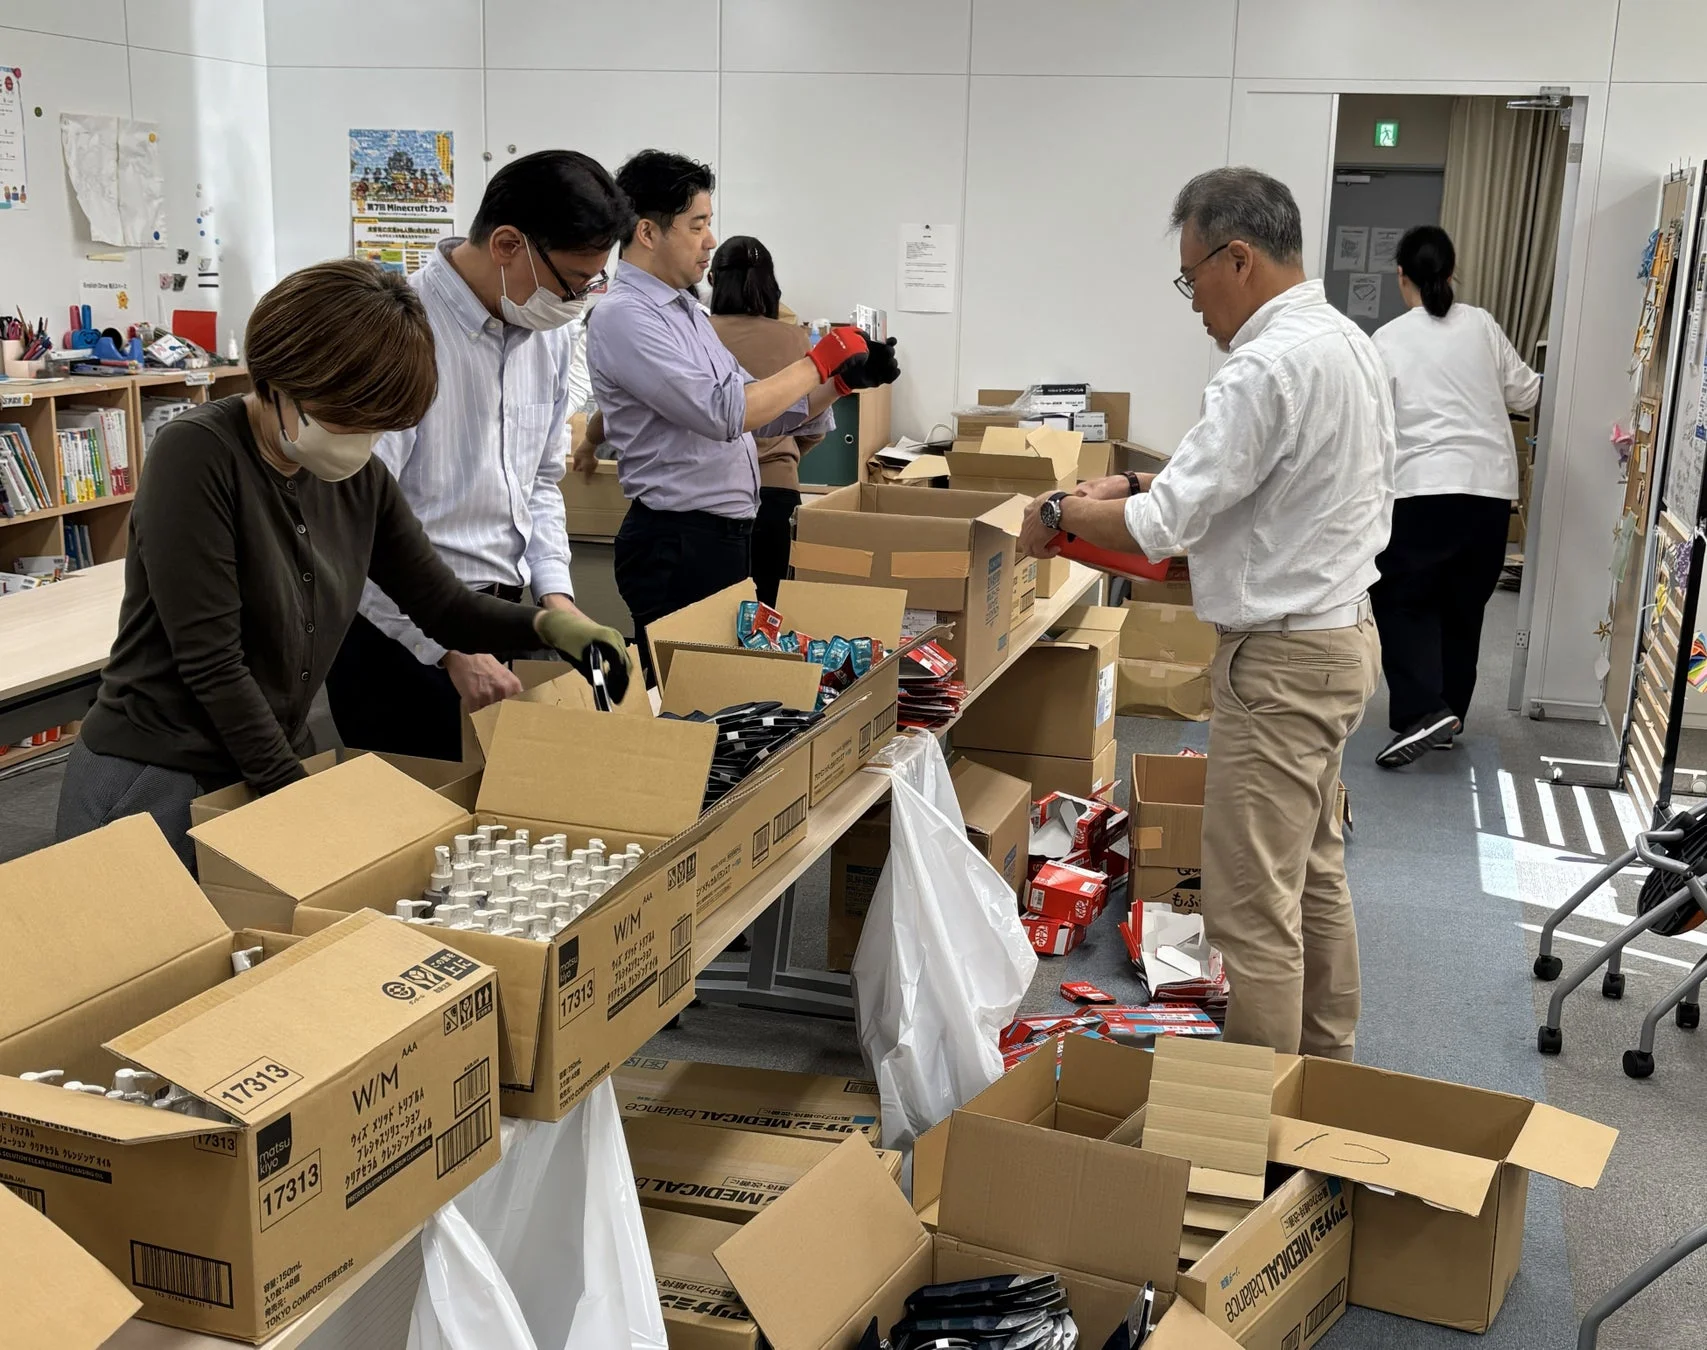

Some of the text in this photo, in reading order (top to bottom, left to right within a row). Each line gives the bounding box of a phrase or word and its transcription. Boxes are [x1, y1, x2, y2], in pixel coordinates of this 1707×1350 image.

[613, 907, 641, 945] W/M
[444, 959, 473, 977] 上に
[561, 979, 593, 1017] 17313
[401, 1041, 418, 1059] AAA
[222, 1064, 290, 1104] 17313
[352, 1062, 399, 1116] W/M
[350, 1086, 425, 1148] ウィズ メソッド トリプルA
[624, 1102, 696, 1118] balance
[697, 1110, 792, 1129] MEDICAL
[197, 1133, 236, 1151] 17313
[259, 1137, 291, 1163] matsu
[260, 1157, 279, 1177] kiyo
[344, 1156, 378, 1190] クリアセラム
[263, 1162, 319, 1216] 17313
[652, 1178, 765, 1206] MEDICAL
[1224, 1195, 1349, 1324] アリナミン MEDICAL balance
[656, 1279, 735, 1299] 集中力の維持・
[265, 1306, 291, 1329] TOKYO
